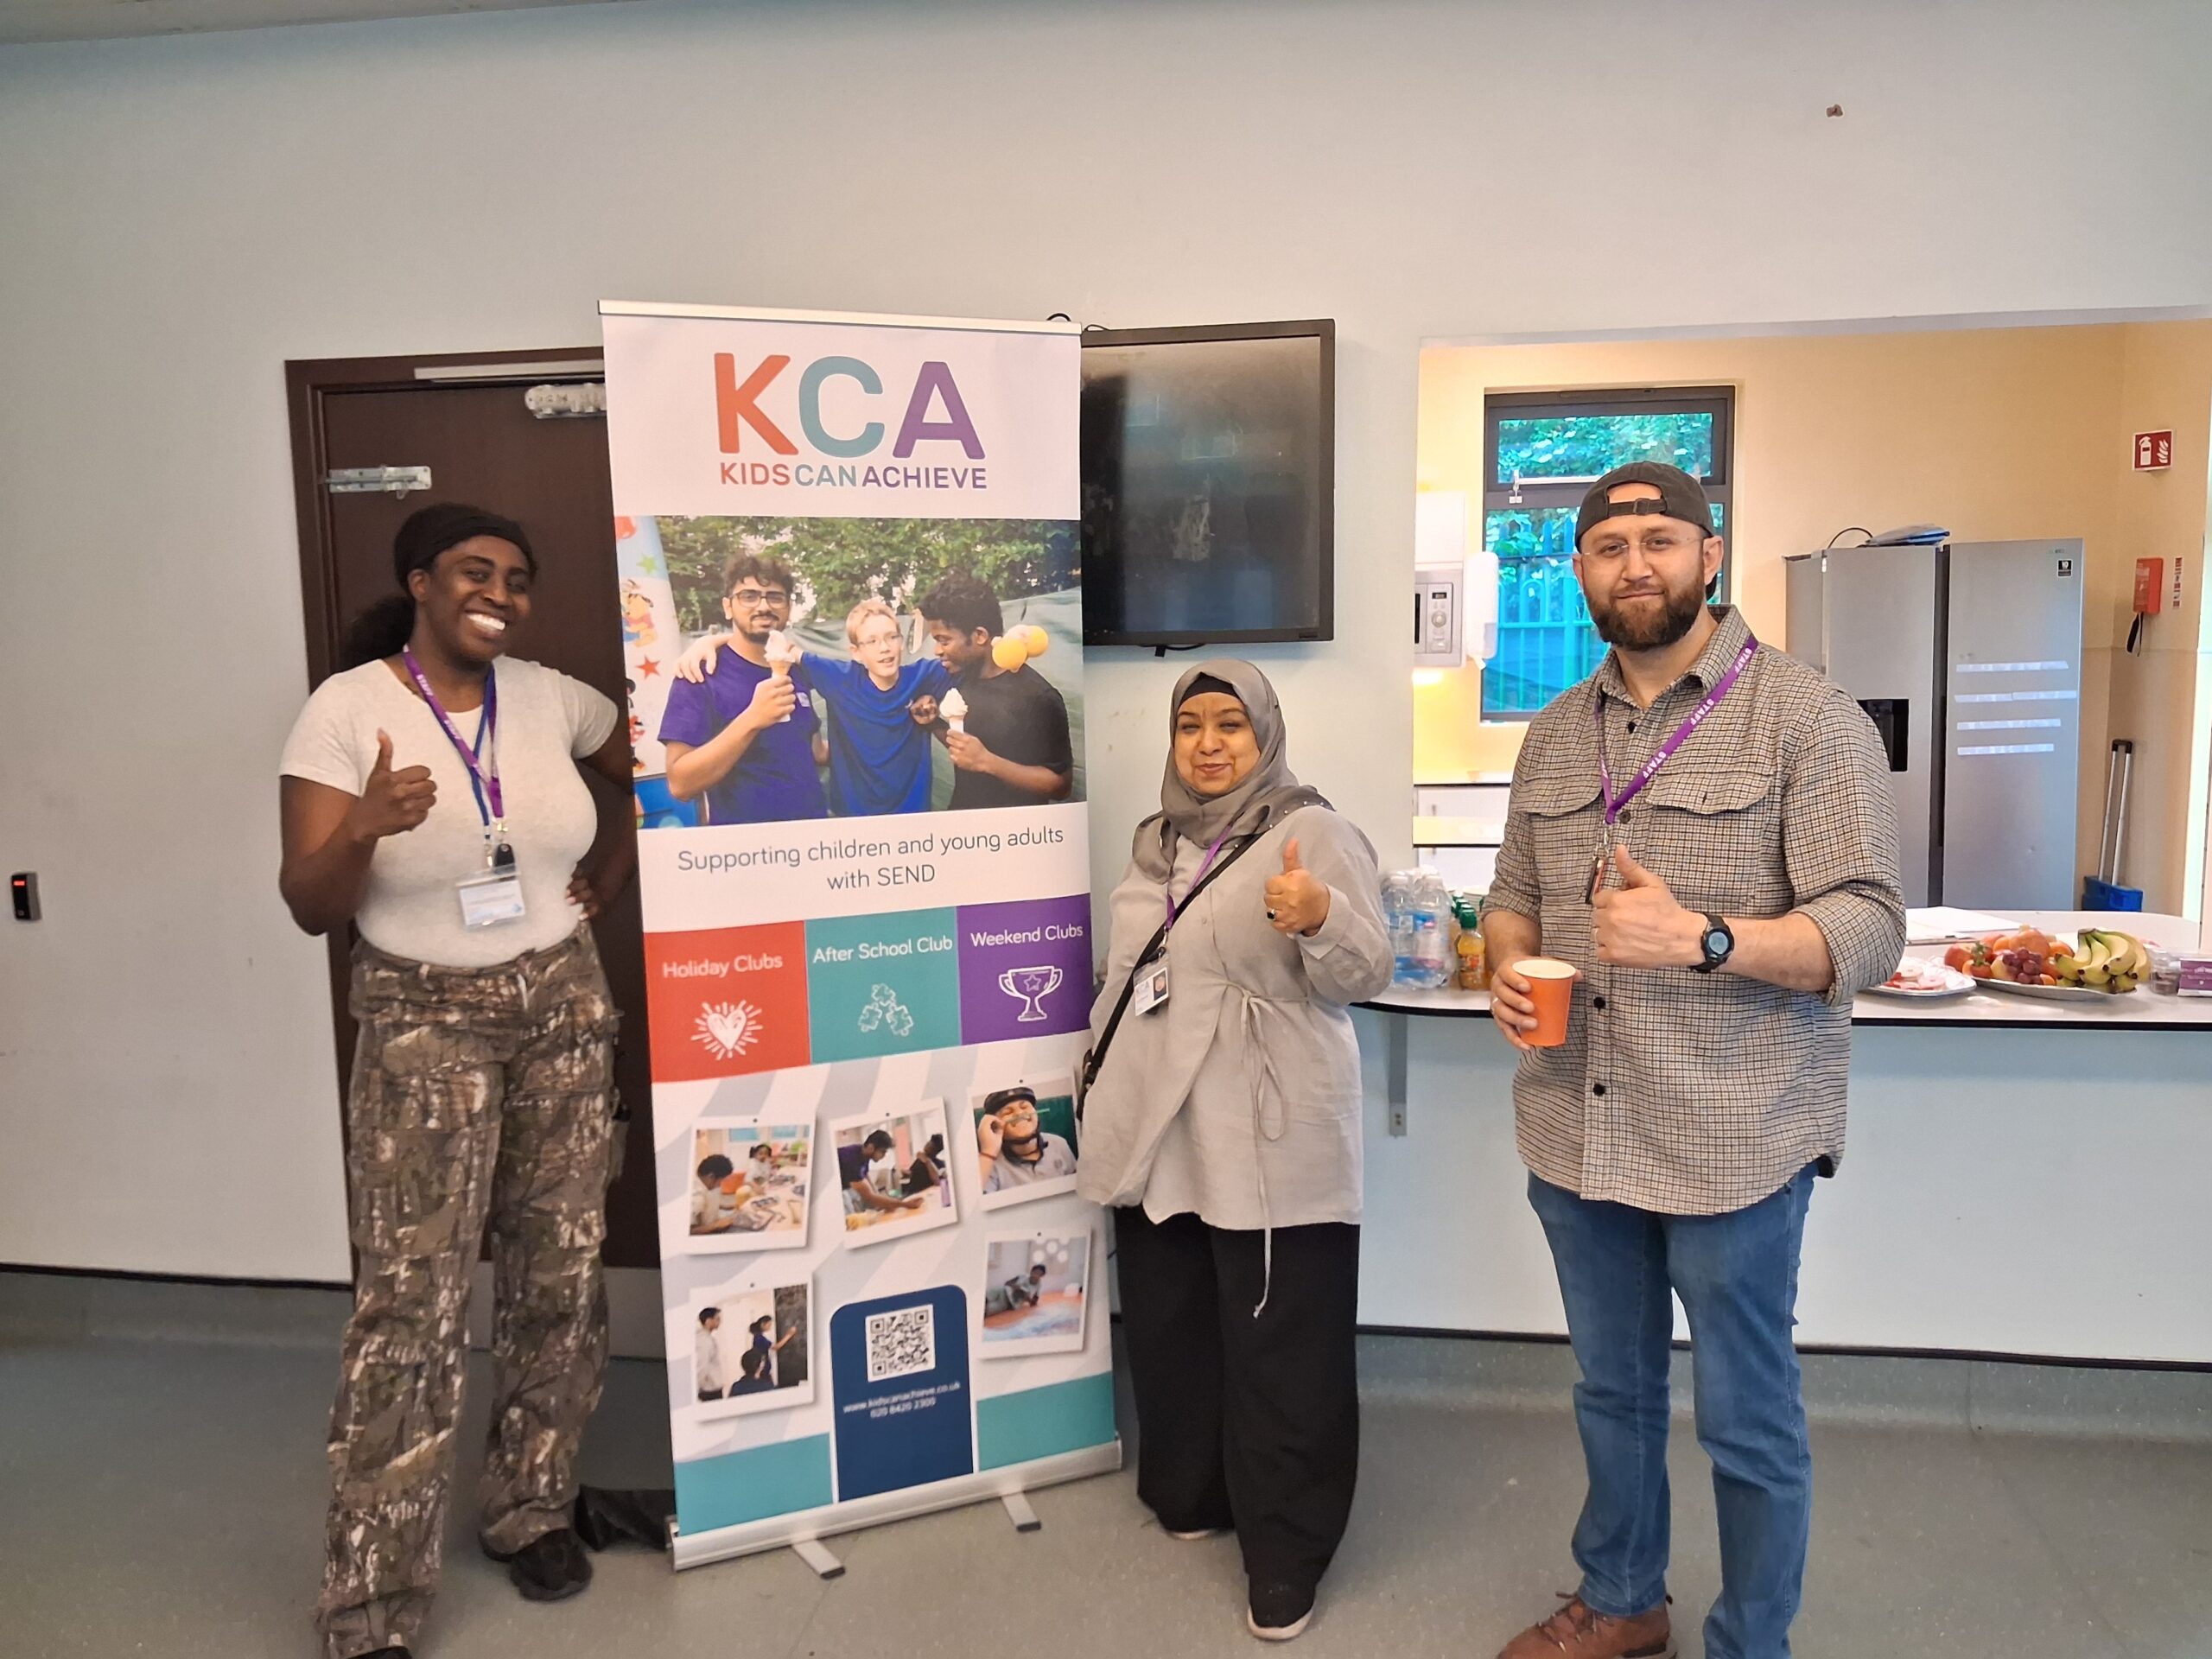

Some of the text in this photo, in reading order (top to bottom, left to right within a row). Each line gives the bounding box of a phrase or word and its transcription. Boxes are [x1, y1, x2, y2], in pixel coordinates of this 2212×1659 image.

[714, 353, 986, 460] KCA
[1690, 698, 1714, 727] STAFF
[1643, 751, 1667, 779] STAFF
[678, 825, 1064, 873] Supporting children and young adults
[827, 864, 936, 890] with SEND
[813, 935, 953, 963] After School Club
[970, 924, 1084, 947] Weekend Clubs
[663, 953, 783, 978] Holiday Clubs
